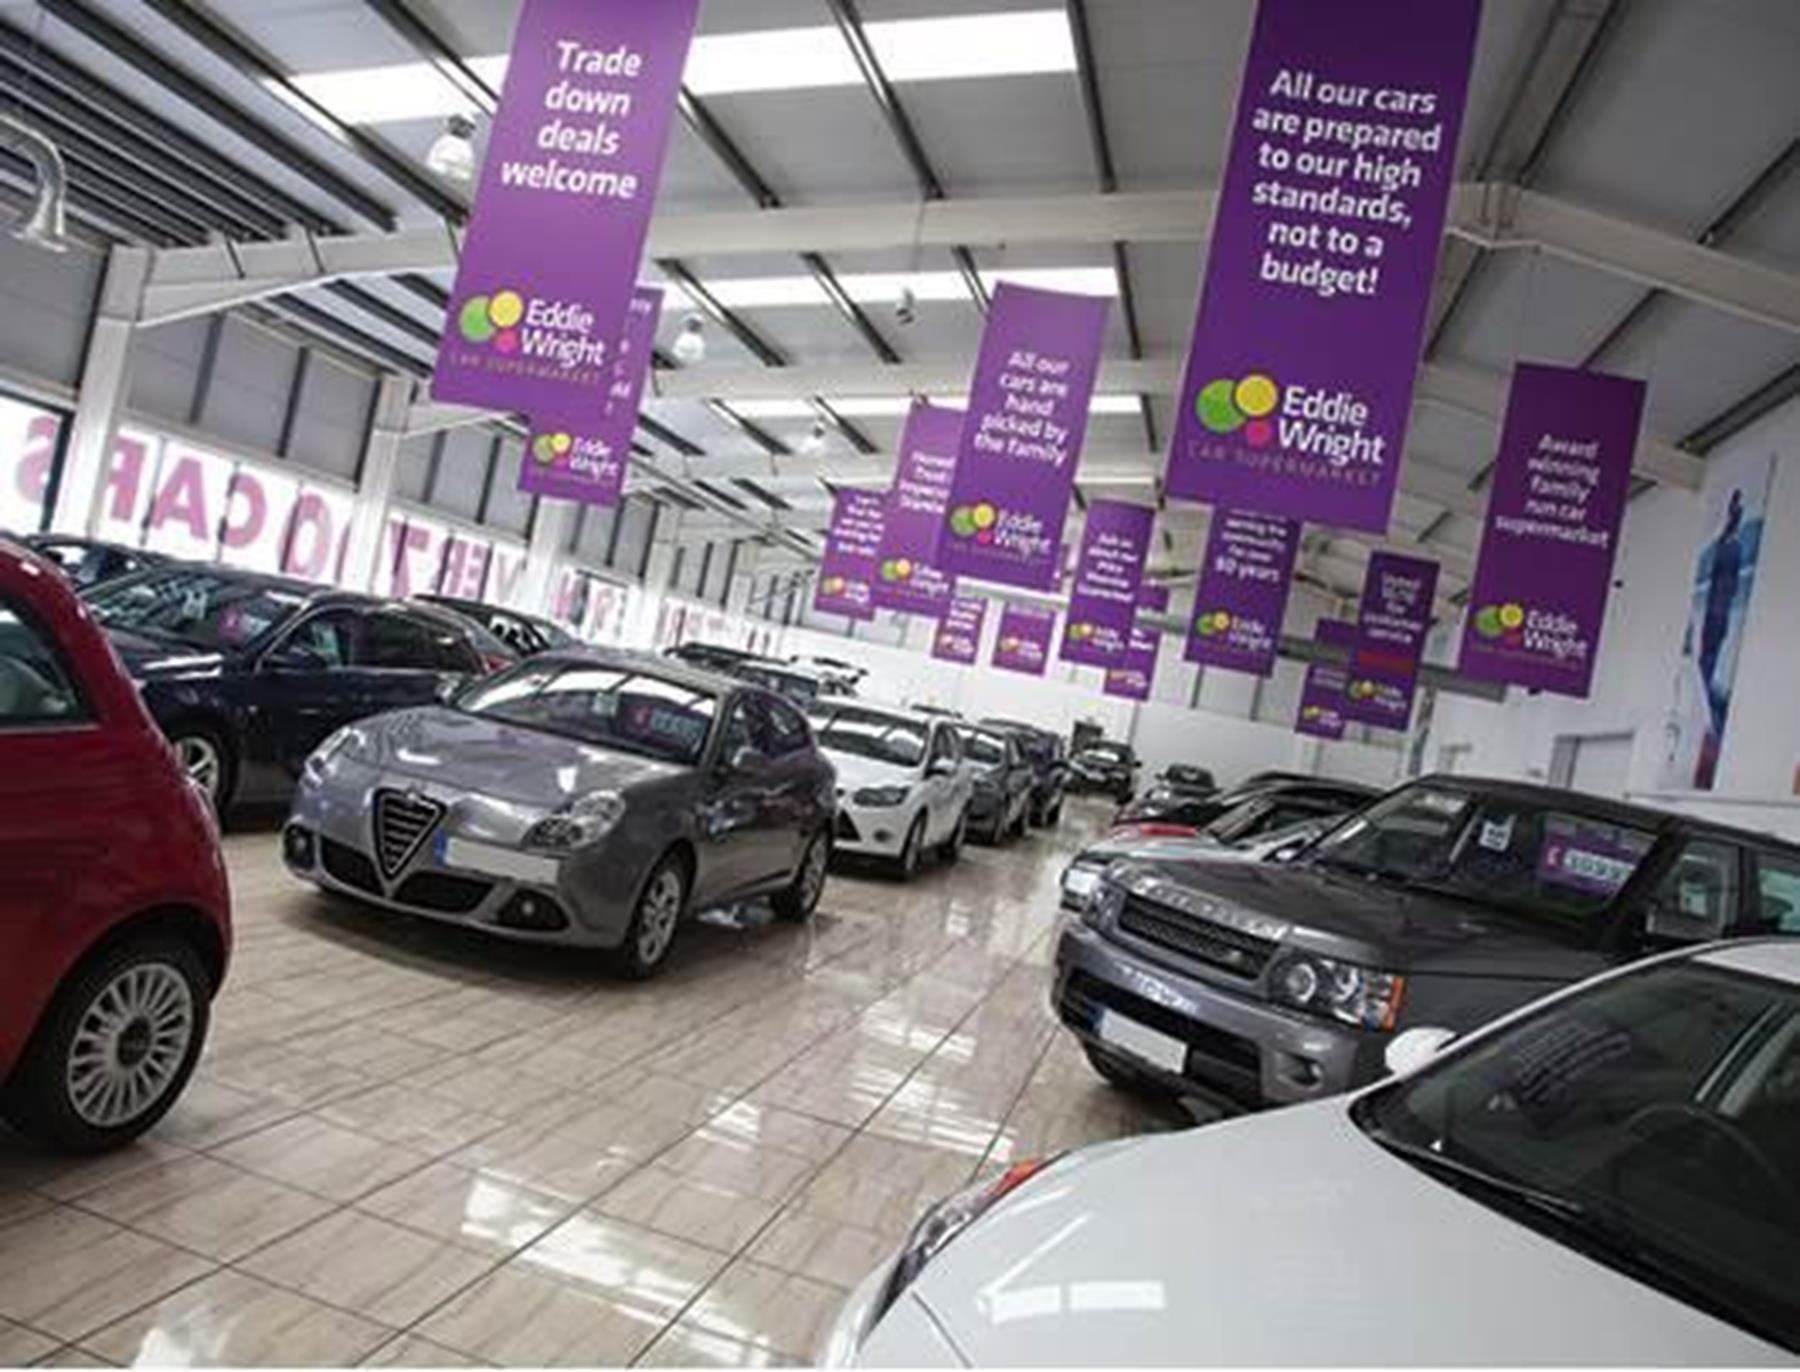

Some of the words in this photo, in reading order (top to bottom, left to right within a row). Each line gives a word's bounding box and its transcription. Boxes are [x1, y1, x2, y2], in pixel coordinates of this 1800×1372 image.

[557, 40, 642, 77] Trade
[545, 80, 631, 116] down
[1270, 70, 1312, 98] All
[1317, 81, 1369, 103] our
[1374, 88, 1436, 113] cars
[538, 121, 620, 156] deals
[1252, 107, 1300, 134] are
[1304, 113, 1441, 151] prepared
[501, 161, 637, 199] welcome
[1258, 144, 1290, 169] to
[1296, 152, 1348, 177] our
[1354, 155, 1421, 191] high
[1252, 181, 1411, 228] standards,
[1268, 222, 1320, 250] not
[1327, 227, 1358, 252] to
[1365, 235, 1383, 257] a
[1260, 253, 1379, 296] budget!
[526, 299, 594, 333] Eddie
[521, 328, 605, 368] Wright
[1000, 374, 1036, 392] cars
[1005, 395, 1054, 415] hand
[1282, 386, 1368, 426] Eddie
[1279, 418, 1386, 466] Wright
[1538, 433, 1600, 459] Award
[1527, 457, 1600, 486] winning
[1530, 475, 1591, 504] family
[1495, 515, 1609, 549] supermarket
[1526, 609, 1578, 634] Eddie
